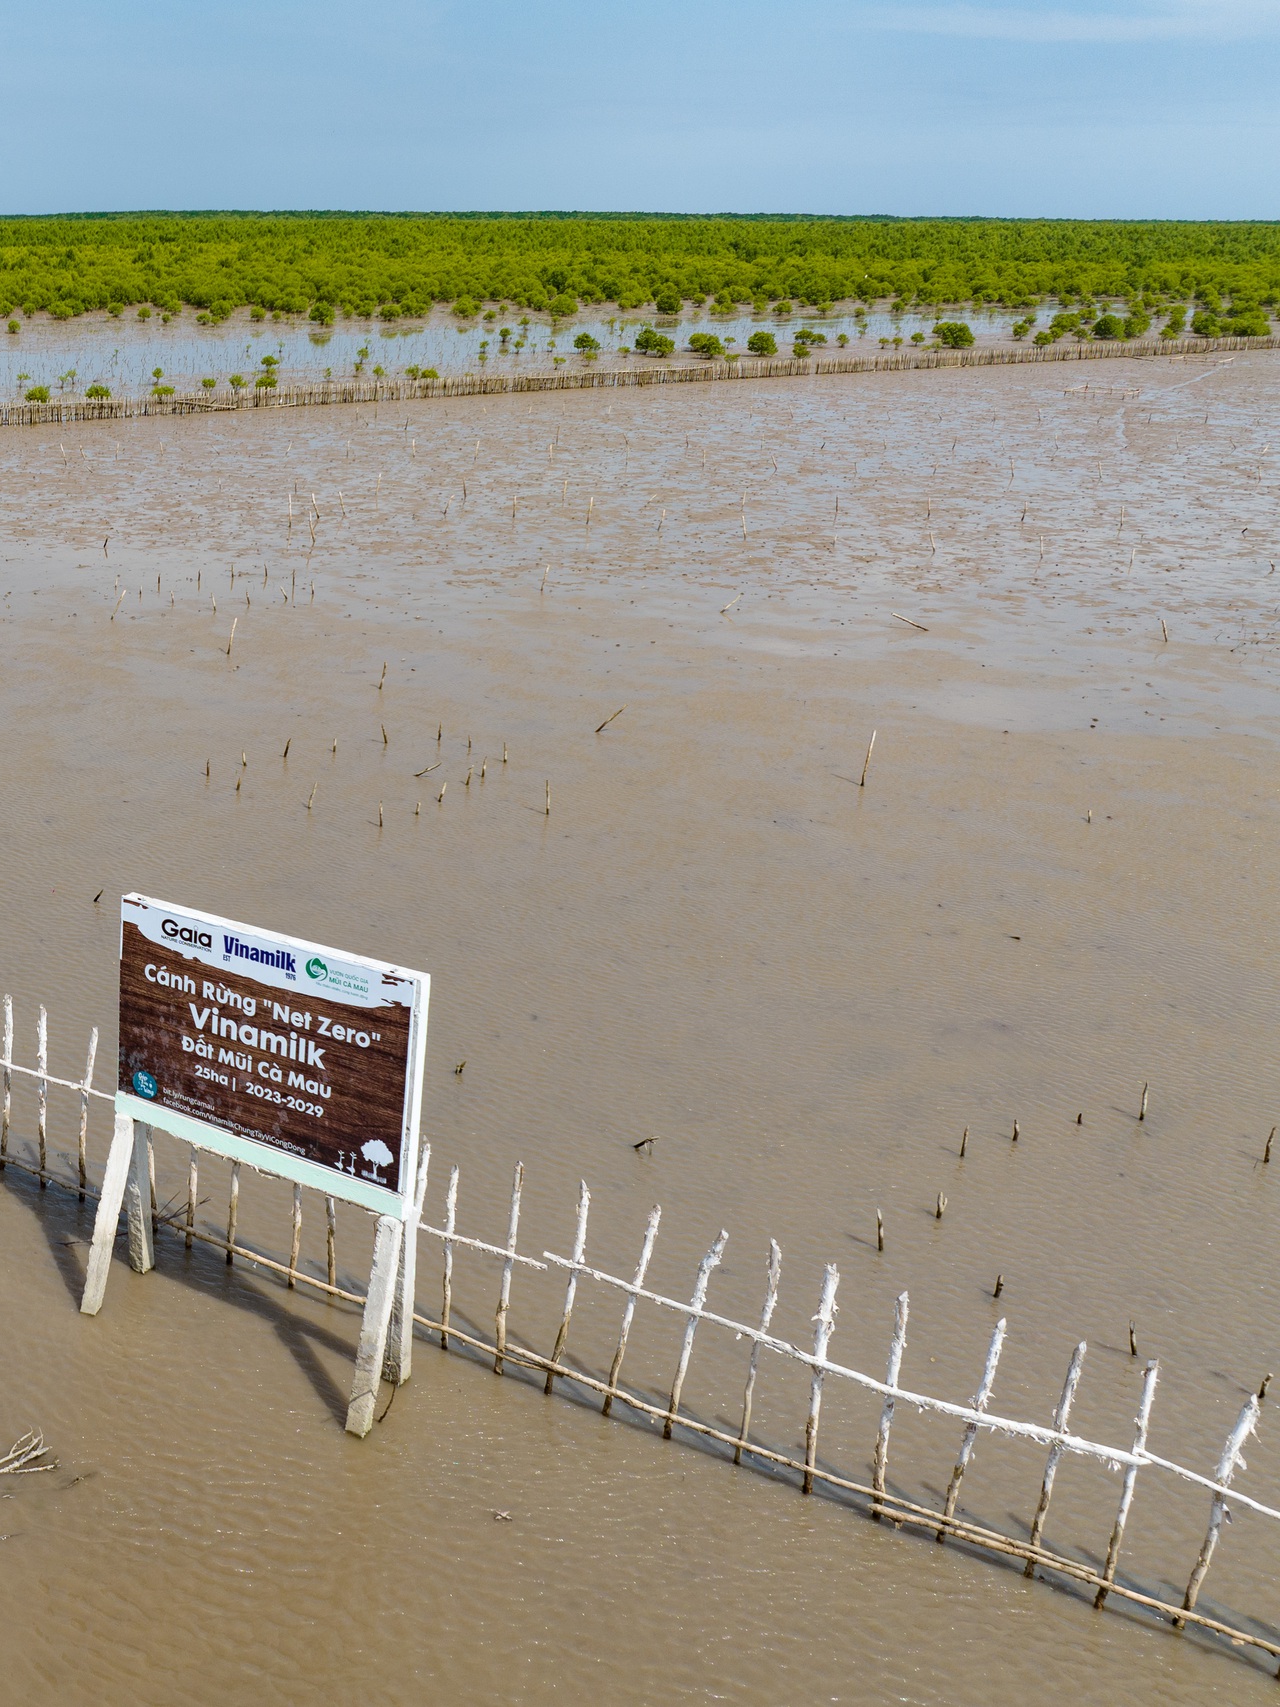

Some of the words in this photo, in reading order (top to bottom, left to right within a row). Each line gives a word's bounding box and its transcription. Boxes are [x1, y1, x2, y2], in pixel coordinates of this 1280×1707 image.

[161, 919, 212, 948] Gaia
[161, 935, 178, 943] NATURE
[179, 940, 212, 953] CONSERVATION
[223, 934, 296, 973] Vinamilk
[223, 954, 231, 962] EST
[285, 972, 296, 981] 1976
[144, 963, 196, 995] Cánh
[202, 980, 256, 1017] Rừng
[263, 999, 312, 1031] "Net
[317, 1016, 381, 1048] Zero"
[343, 980, 352, 989] CÀ
[353, 984, 369, 993] MAU
[189, 1003, 326, 1071] Vinamilk
[181, 1033, 214, 1060] Đất
[218, 1047, 252, 1073] Mũi
[257, 1060, 282, 1083] Cà
[287, 1070, 332, 1099] Mau
[162, 1087, 215, 1111] bit.ly/rungcamau
[194, 1064, 229, 1087] 25ha
[245, 1082, 324, 1118] 2023-2029
[163, 1097, 306, 1156] facebook.com/VinamilkChungTayViCongDong
